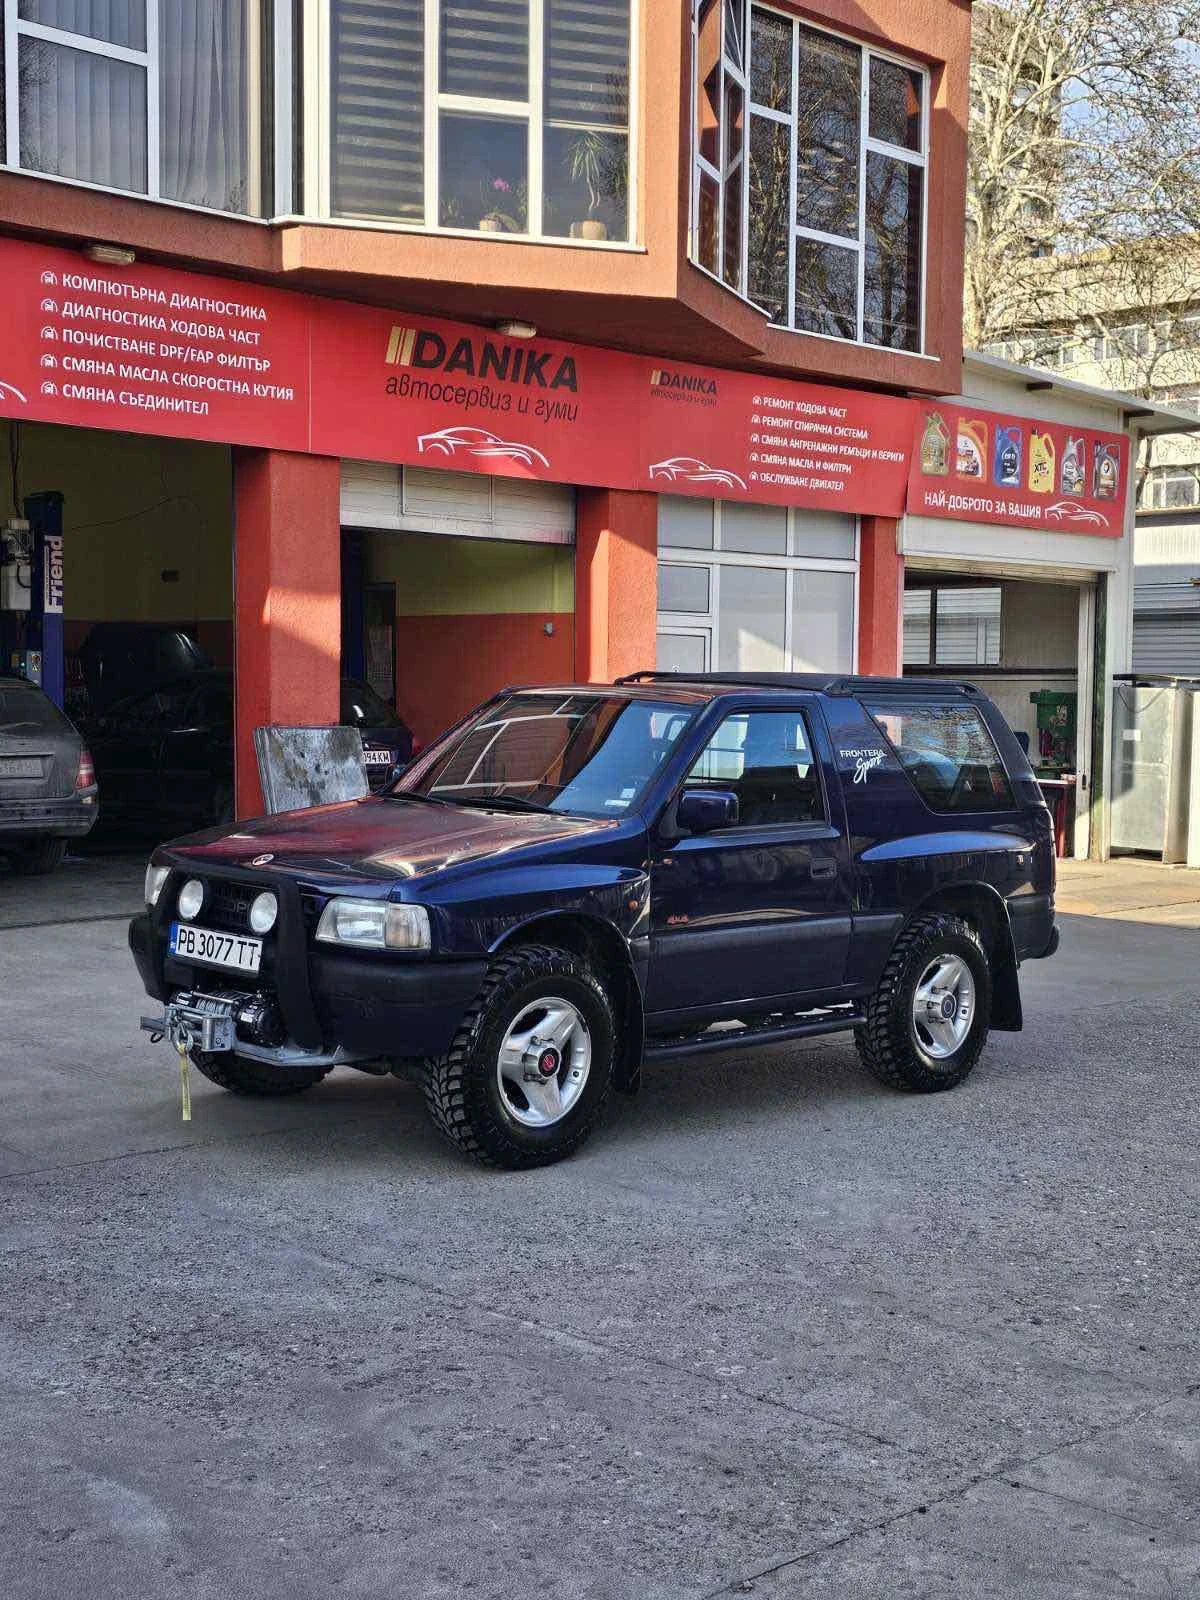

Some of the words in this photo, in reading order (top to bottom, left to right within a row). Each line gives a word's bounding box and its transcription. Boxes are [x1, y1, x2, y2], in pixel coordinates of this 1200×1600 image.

[62, 273, 167, 304] КОМПЮТЪРНА
[169, 292, 267, 321] ДИАГНОСТИКА
[62, 301, 166, 331] ДИАГНОСТИКА
[170, 316, 225, 340] ХОДОВА
[228, 328, 261, 345] ЧАСТ
[62, 329, 156, 355] ПОЧИСТВАНЕ
[160, 342, 214, 364] DPF/FAP
[217, 352, 271, 372] ФИЛТЪР
[412, 329, 578, 393] DANIKA
[62, 356, 115, 376] СМЯНА
[119, 363, 168, 384] МАСЛА
[172, 371, 250, 396] СКОРОСТНА
[253, 385, 294, 401] КУТИЯ
[659, 370, 717, 394] DANIKA
[62, 383, 116, 404] СМЯНА
[119, 391, 209, 416] СЪЕДИНИТЕЛ
[385, 373, 512, 411] автосервиз
[518, 398, 529, 413] и
[534, 399, 580, 423] гуми
[763, 395, 794, 411] РЕМОНТ
[796, 402, 827, 416] ХОДОВА
[828, 406, 847, 418] ЧАСТ
[762, 415, 793, 430] РЕМОНТ
[794, 420, 833, 436] СПИРАЧНА
[834, 426, 869, 440] СИСТЕМА
[760, 453, 788, 466] СМЯНА
[788, 456, 814, 470] МАСЛА
[815, 460, 822, 470] И
[822, 461, 852, 474] ФИЛТРИ
[761, 434, 789, 448] СМЯНА
[789, 438, 838, 453] АНГРЕНАЖНИ
[839, 445, 871, 460] РЕМЪЦИ
[871, 449, 878, 459] И
[878, 450, 905, 463] ВЕРИГИ
[760, 471, 809, 487] ОБСЛУЖВАНЕ
[809, 477, 844, 491] ДВИГАТЕЛ
[924, 489, 993, 513] НАЙ-ДОБРОТО
[994, 501, 1007, 513] ЗА
[1008, 504, 1041, 519] ВАШИЯ
[44, 535, 63, 613] Friend
[840, 748, 885, 758] FRONTERA
[178, 928, 195, 954] PB
[198, 933, 234, 961] 3077
[237, 940, 259, 967] TT
